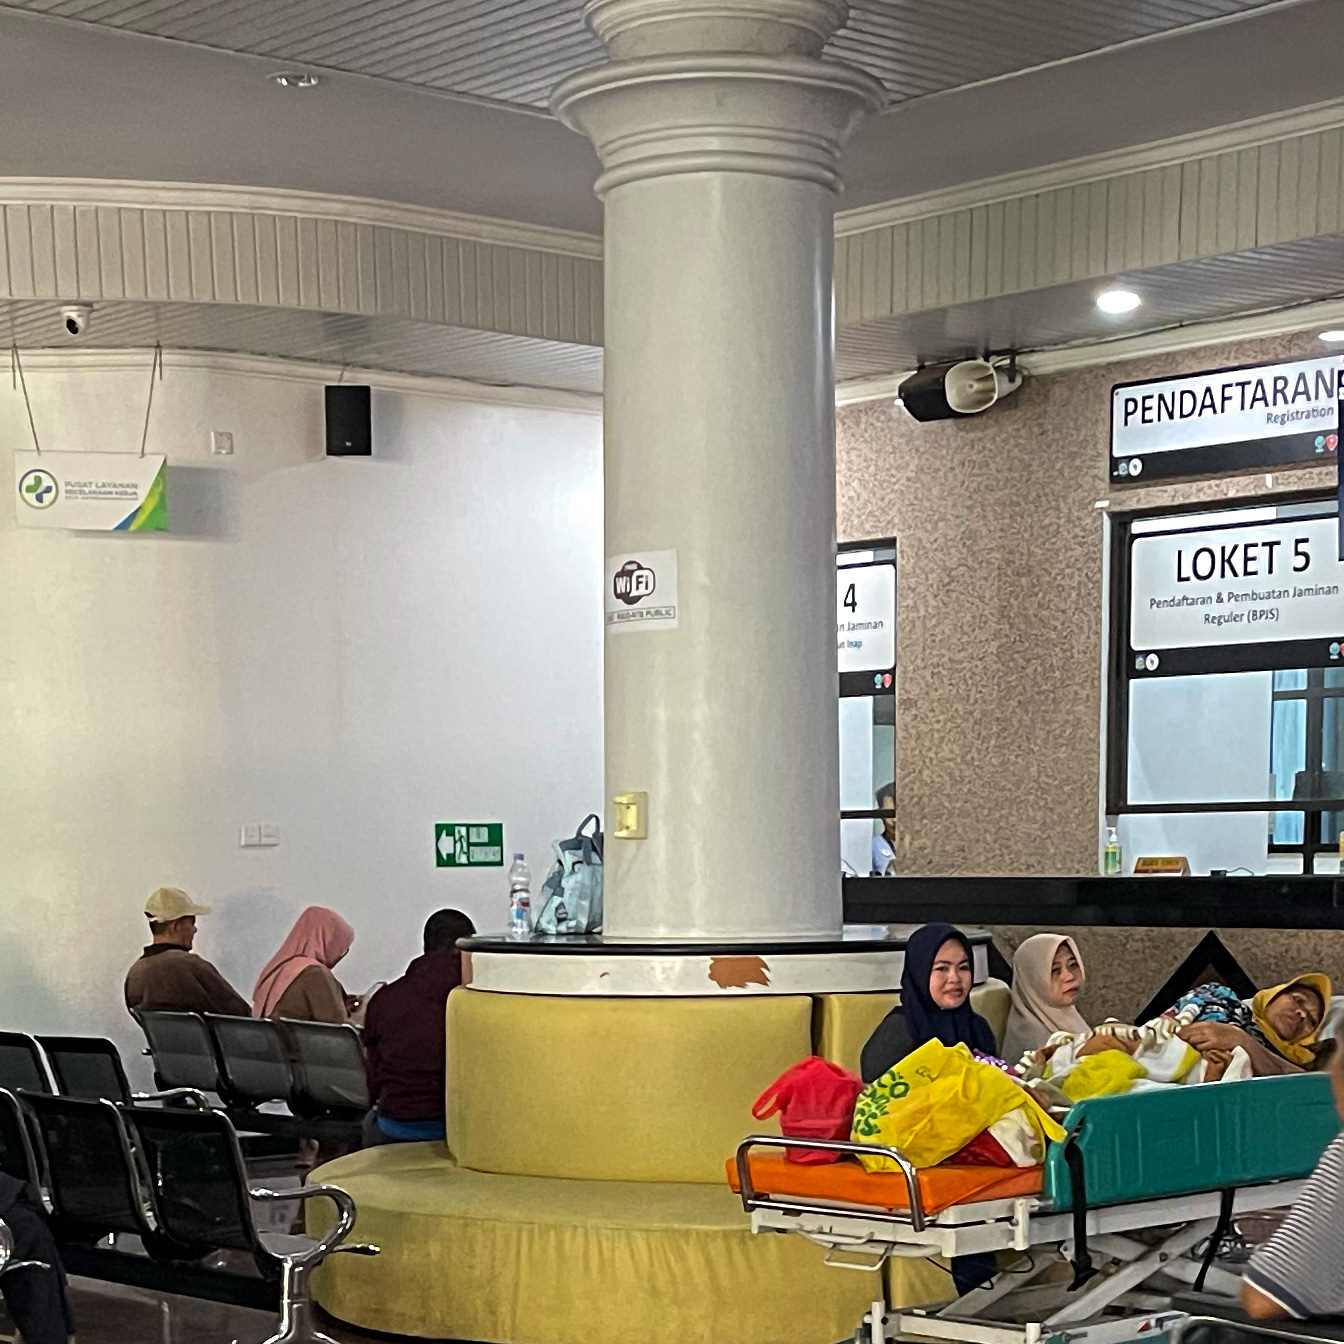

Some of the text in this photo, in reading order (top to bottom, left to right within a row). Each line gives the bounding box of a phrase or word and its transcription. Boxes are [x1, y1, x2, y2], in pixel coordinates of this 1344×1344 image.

[1123, 367, 1336, 428] PENDAFTARAN
[1266, 405, 1335, 426] Registration
[1176, 537, 1312, 583] LOKET 5
[843, 583, 857, 613] 4
[1149, 584, 1339, 609] Pendaftaran & Pembuatan Jaminan
[847, 620, 884, 632] Jaminan
[1203, 611, 1244, 626] Reguler
